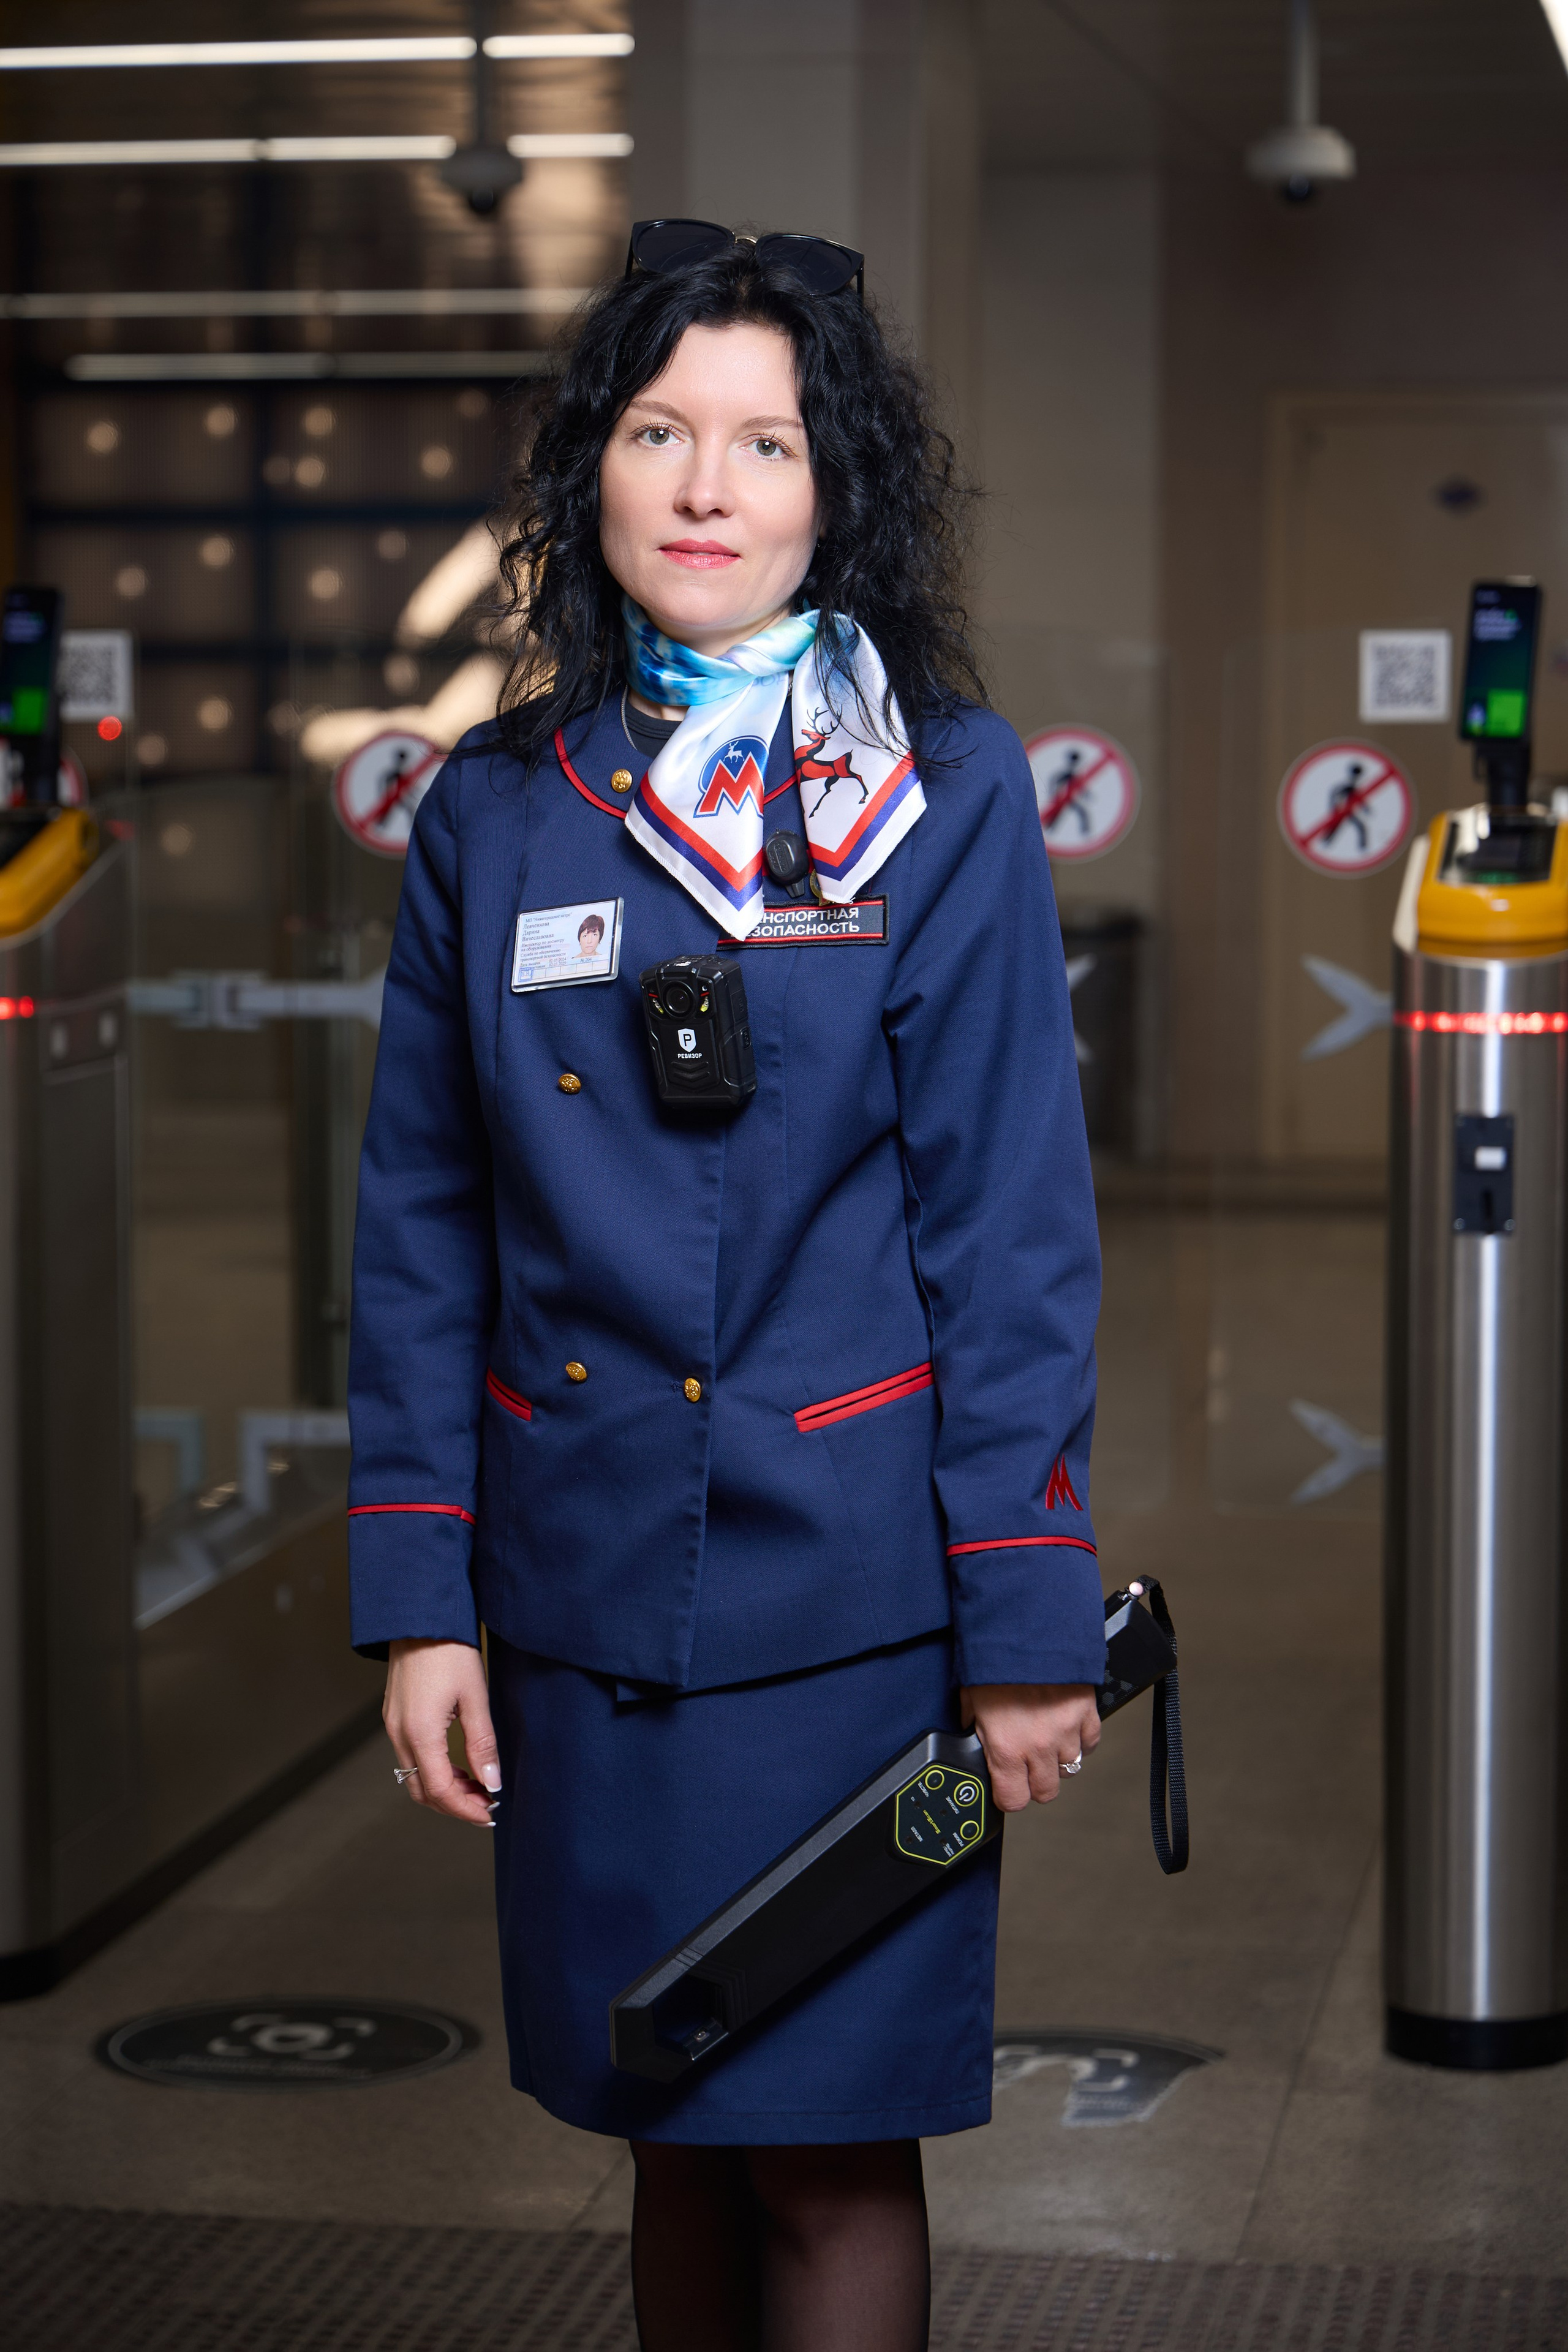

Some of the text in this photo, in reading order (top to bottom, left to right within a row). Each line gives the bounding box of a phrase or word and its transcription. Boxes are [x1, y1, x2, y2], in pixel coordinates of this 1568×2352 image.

[760, 907, 859, 924] НСПОРТНАЯ
[747, 921, 860, 937] ЗОПАСНОСТЬ
[522, 934, 554, 942] Вячеславовна
[945, 1796, 960, 1815] ПИТАНИЕ
[952, 1832, 965, 1847] РЕЖИМ
